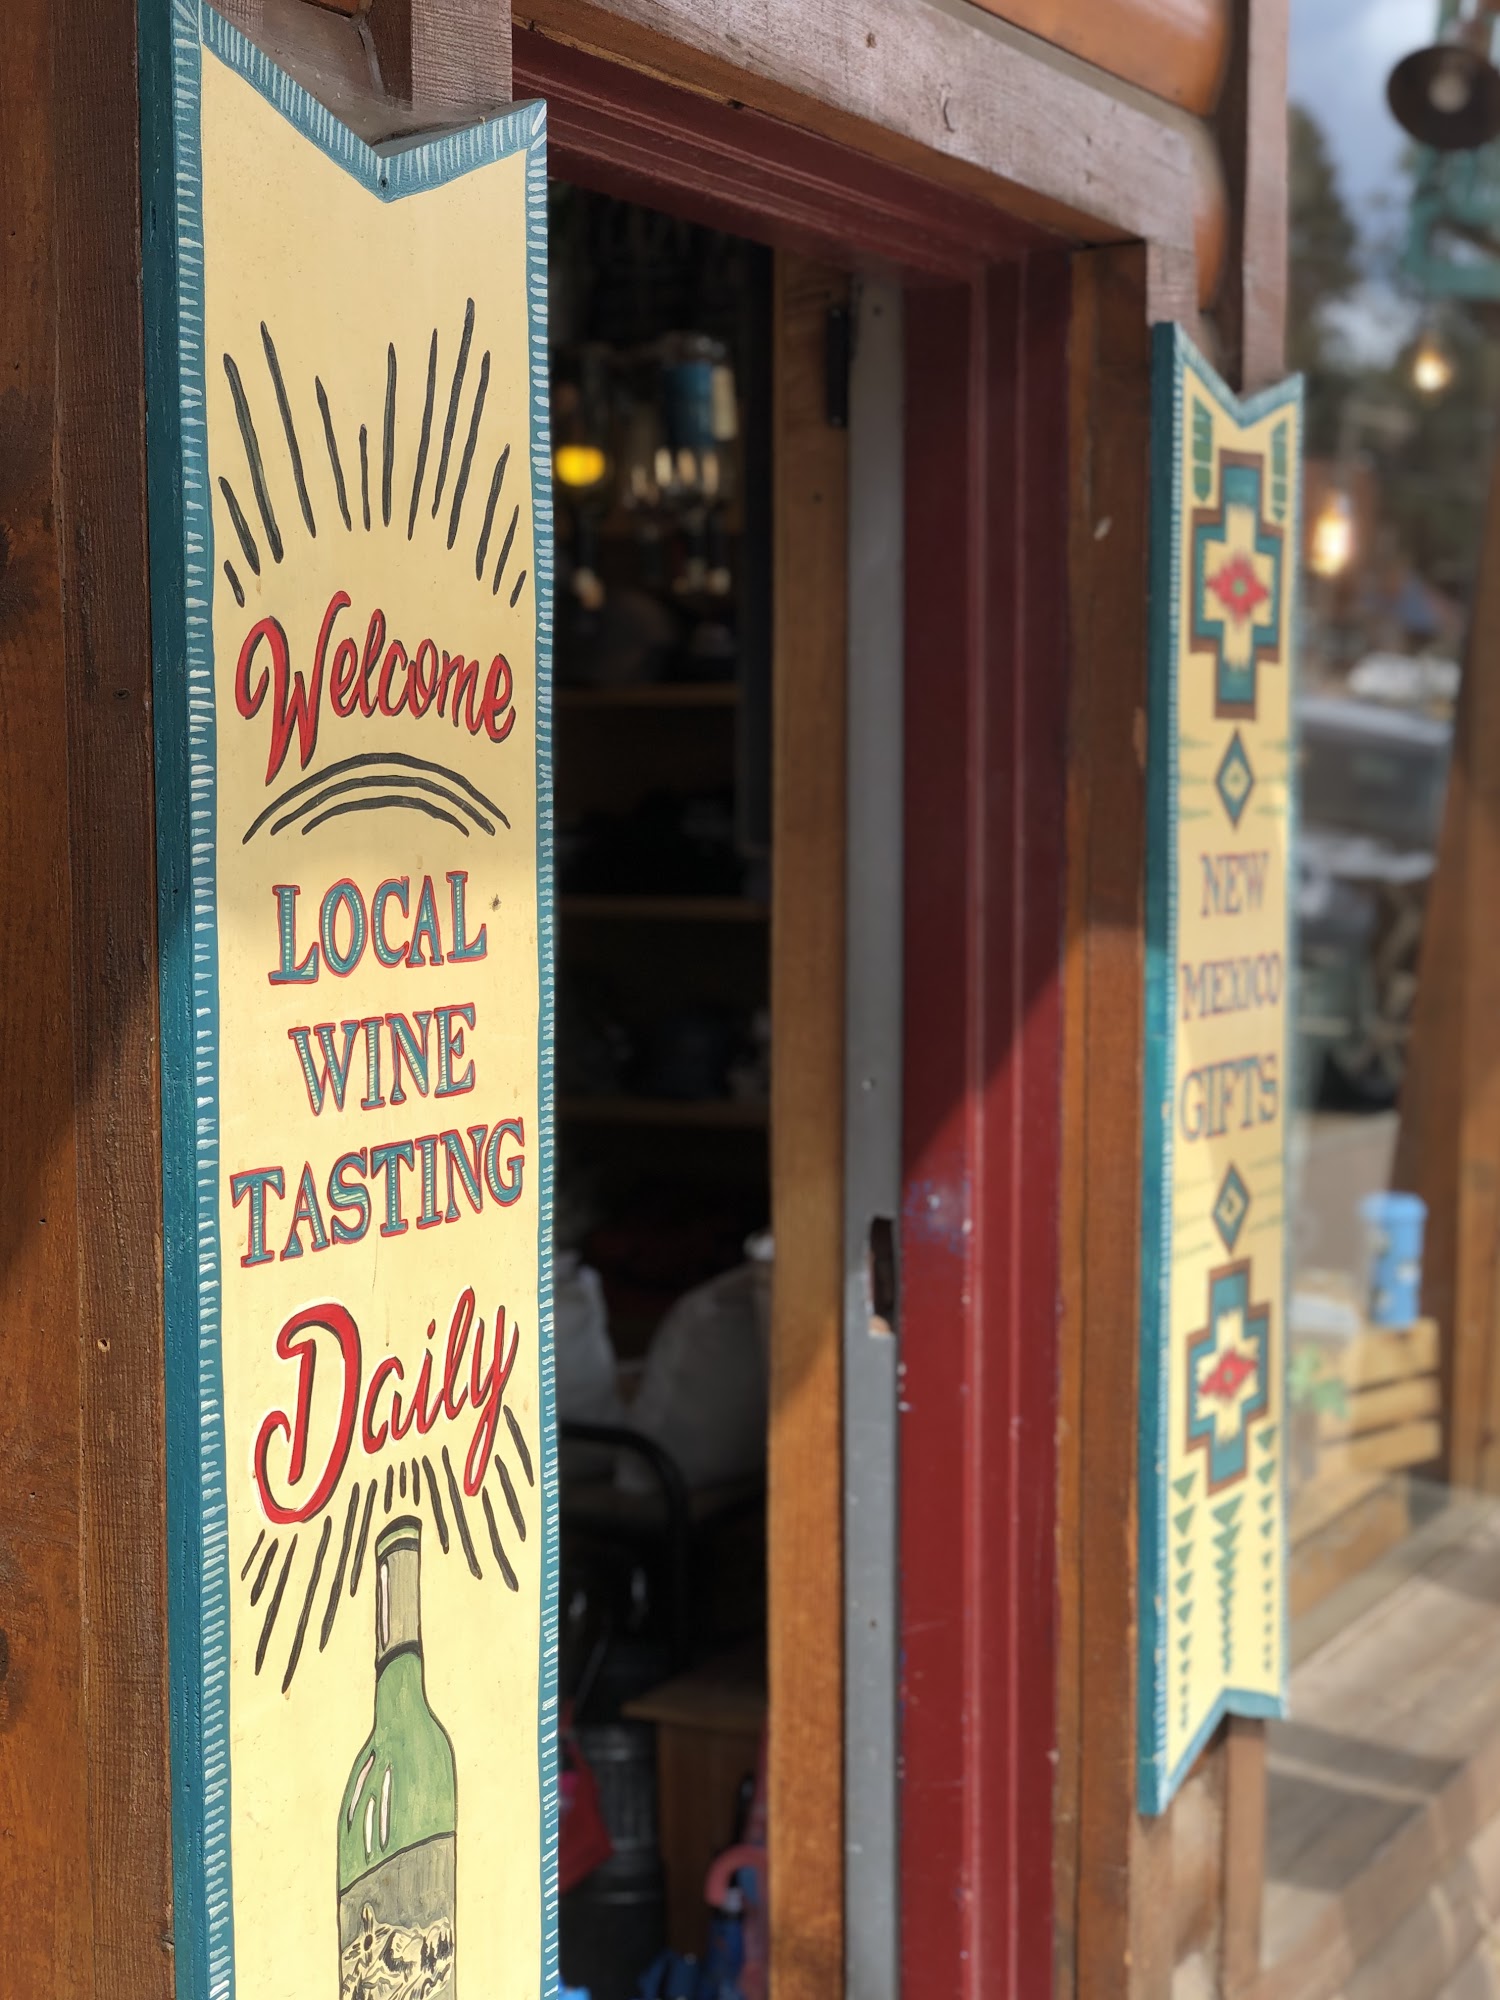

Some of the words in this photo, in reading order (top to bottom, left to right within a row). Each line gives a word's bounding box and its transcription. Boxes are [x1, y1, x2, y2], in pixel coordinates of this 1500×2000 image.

[235, 590, 517, 786] Welcome
[268, 871, 488, 986] LOCAL
[1200, 850, 1270, 918] NEW
[1181, 951, 1281, 1021] MEXICO
[288, 1003, 476, 1116] WINE
[1179, 1053, 1279, 1142] GIFTS
[229, 1117, 526, 1269] TASTING
[252, 1284, 520, 1524] Daily
